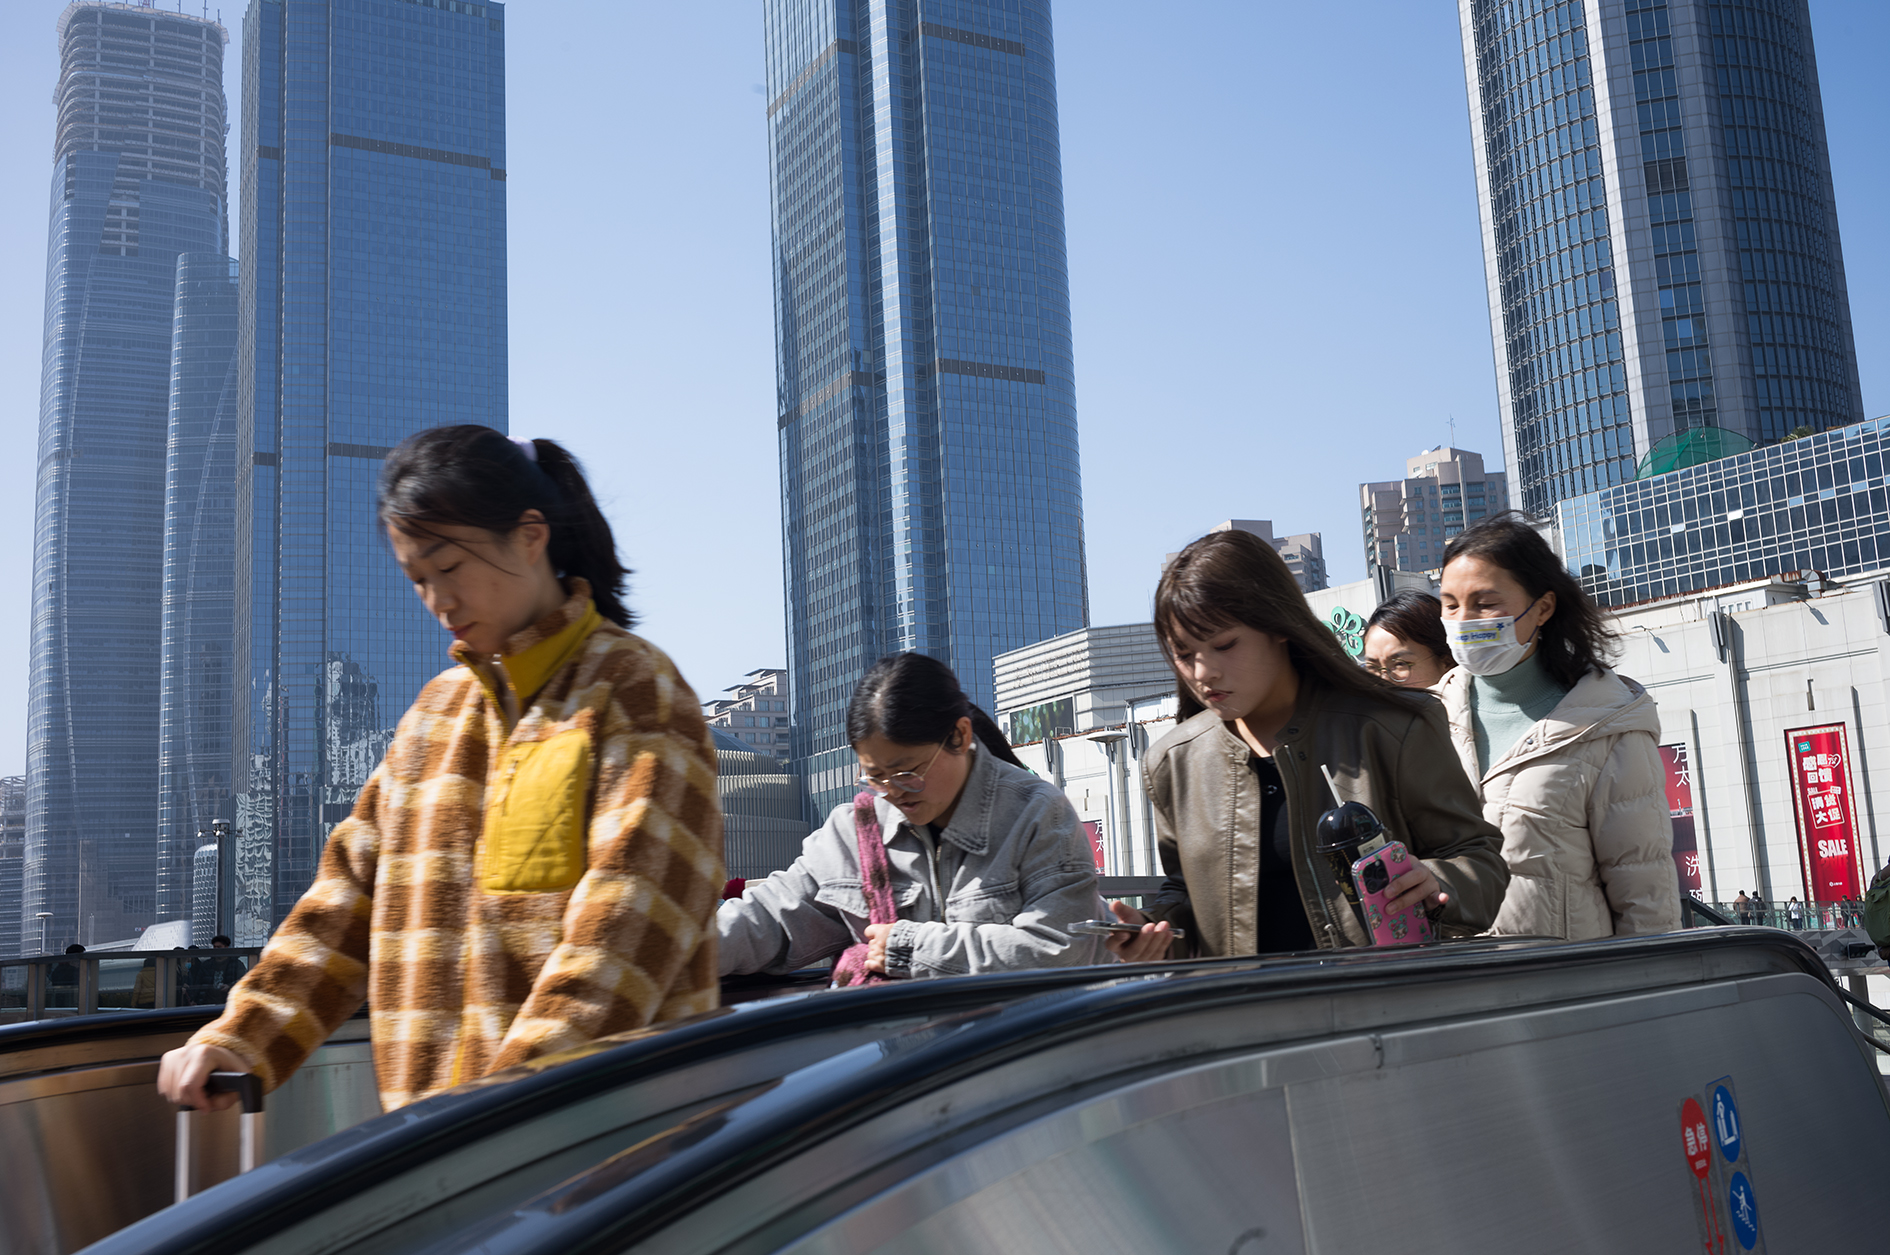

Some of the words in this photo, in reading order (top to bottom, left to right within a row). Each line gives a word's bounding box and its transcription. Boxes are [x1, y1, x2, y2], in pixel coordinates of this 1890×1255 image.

[1471, 632, 1496, 640] Happy
[1811, 793, 1837, 810] 清货
[1815, 807, 1841, 825] 大促
[1817, 839, 1848, 858] SALE
